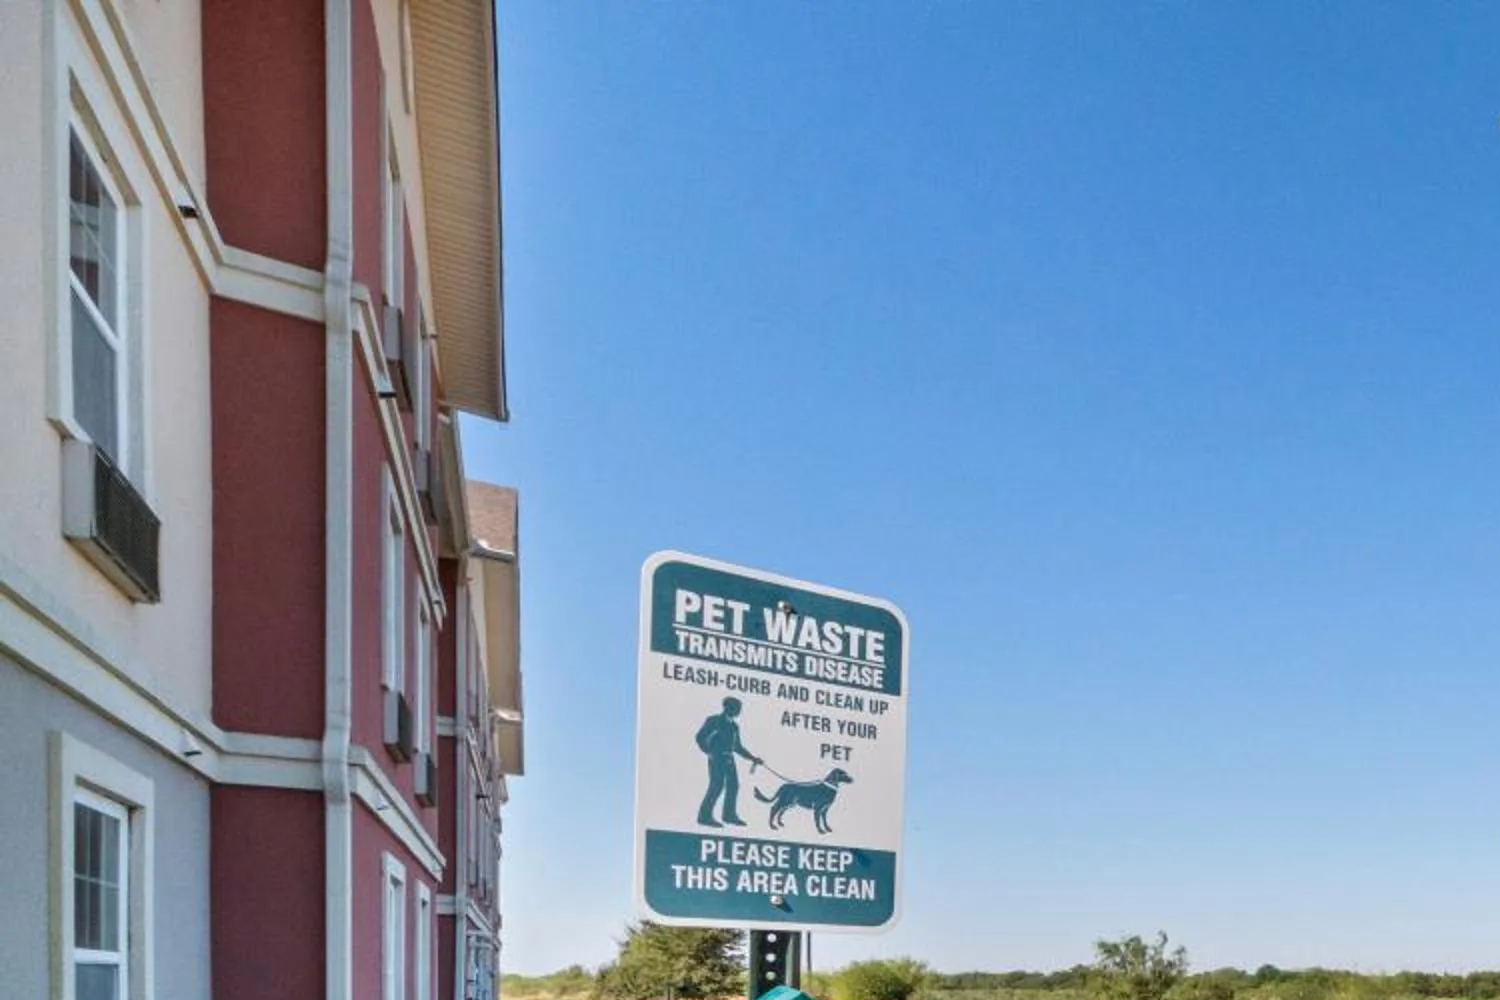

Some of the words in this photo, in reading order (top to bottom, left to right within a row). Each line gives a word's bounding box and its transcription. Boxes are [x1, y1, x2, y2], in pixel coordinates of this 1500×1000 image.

[675, 588, 751, 635] PET
[763, 606, 886, 663] WASTE
[675, 629, 799, 674] TRANSMITS
[804, 655, 885, 689] DISEASE
[662, 661, 772, 697] LEASH-CURB
[776, 682, 810, 704] AND
[814, 689, 865, 713] CLEAN
[868, 699, 890, 716] UP
[780, 710, 832, 734] AFTER
[836, 719, 878, 741] YOUR
[819, 743, 854, 762] PET
[700, 839, 790, 869] PLEASE
[797, 848, 853, 873] KEEP
[671, 864, 729, 892] THIS
[736, 869, 800, 897] AREA
[805, 874, 876, 901] CLEAN
